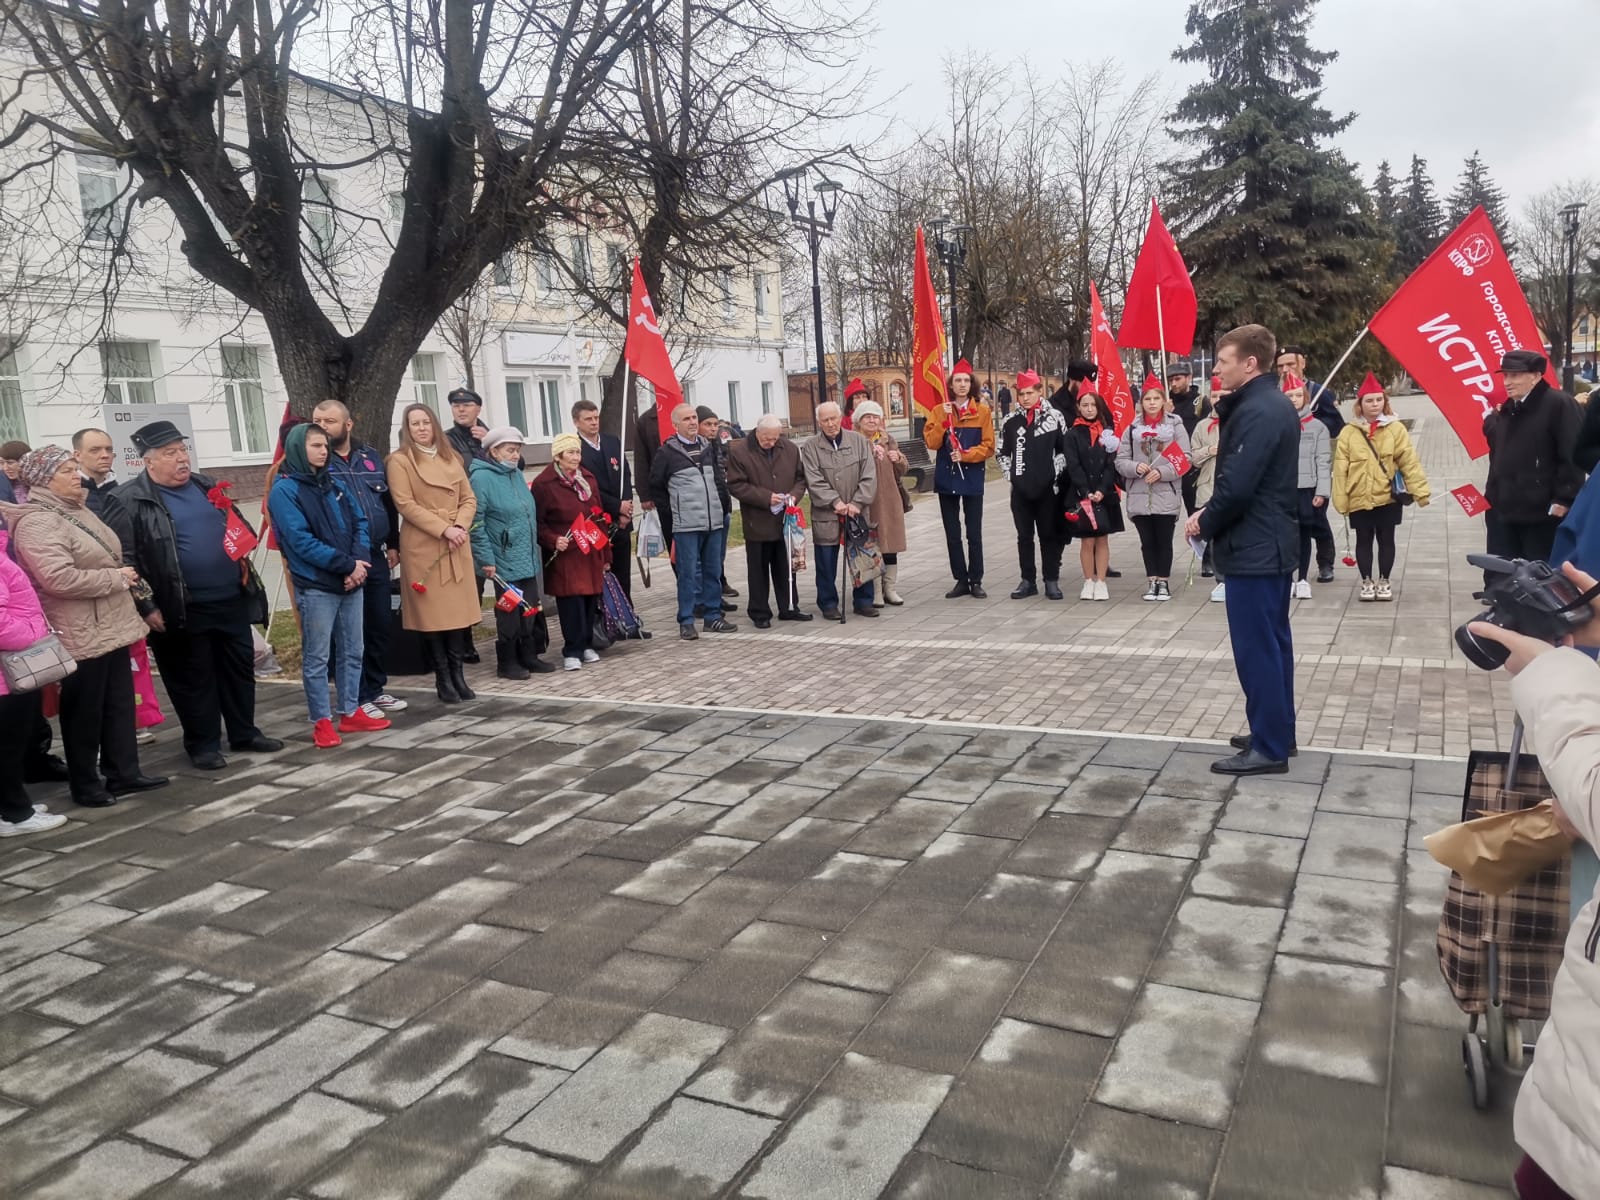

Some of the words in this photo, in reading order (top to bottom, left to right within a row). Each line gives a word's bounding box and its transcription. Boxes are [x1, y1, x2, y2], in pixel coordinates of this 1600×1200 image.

[1447, 248, 1474, 276] КПРФ
[1486, 329, 1506, 366] КПР
[1015, 436, 1026, 476] Columbia
